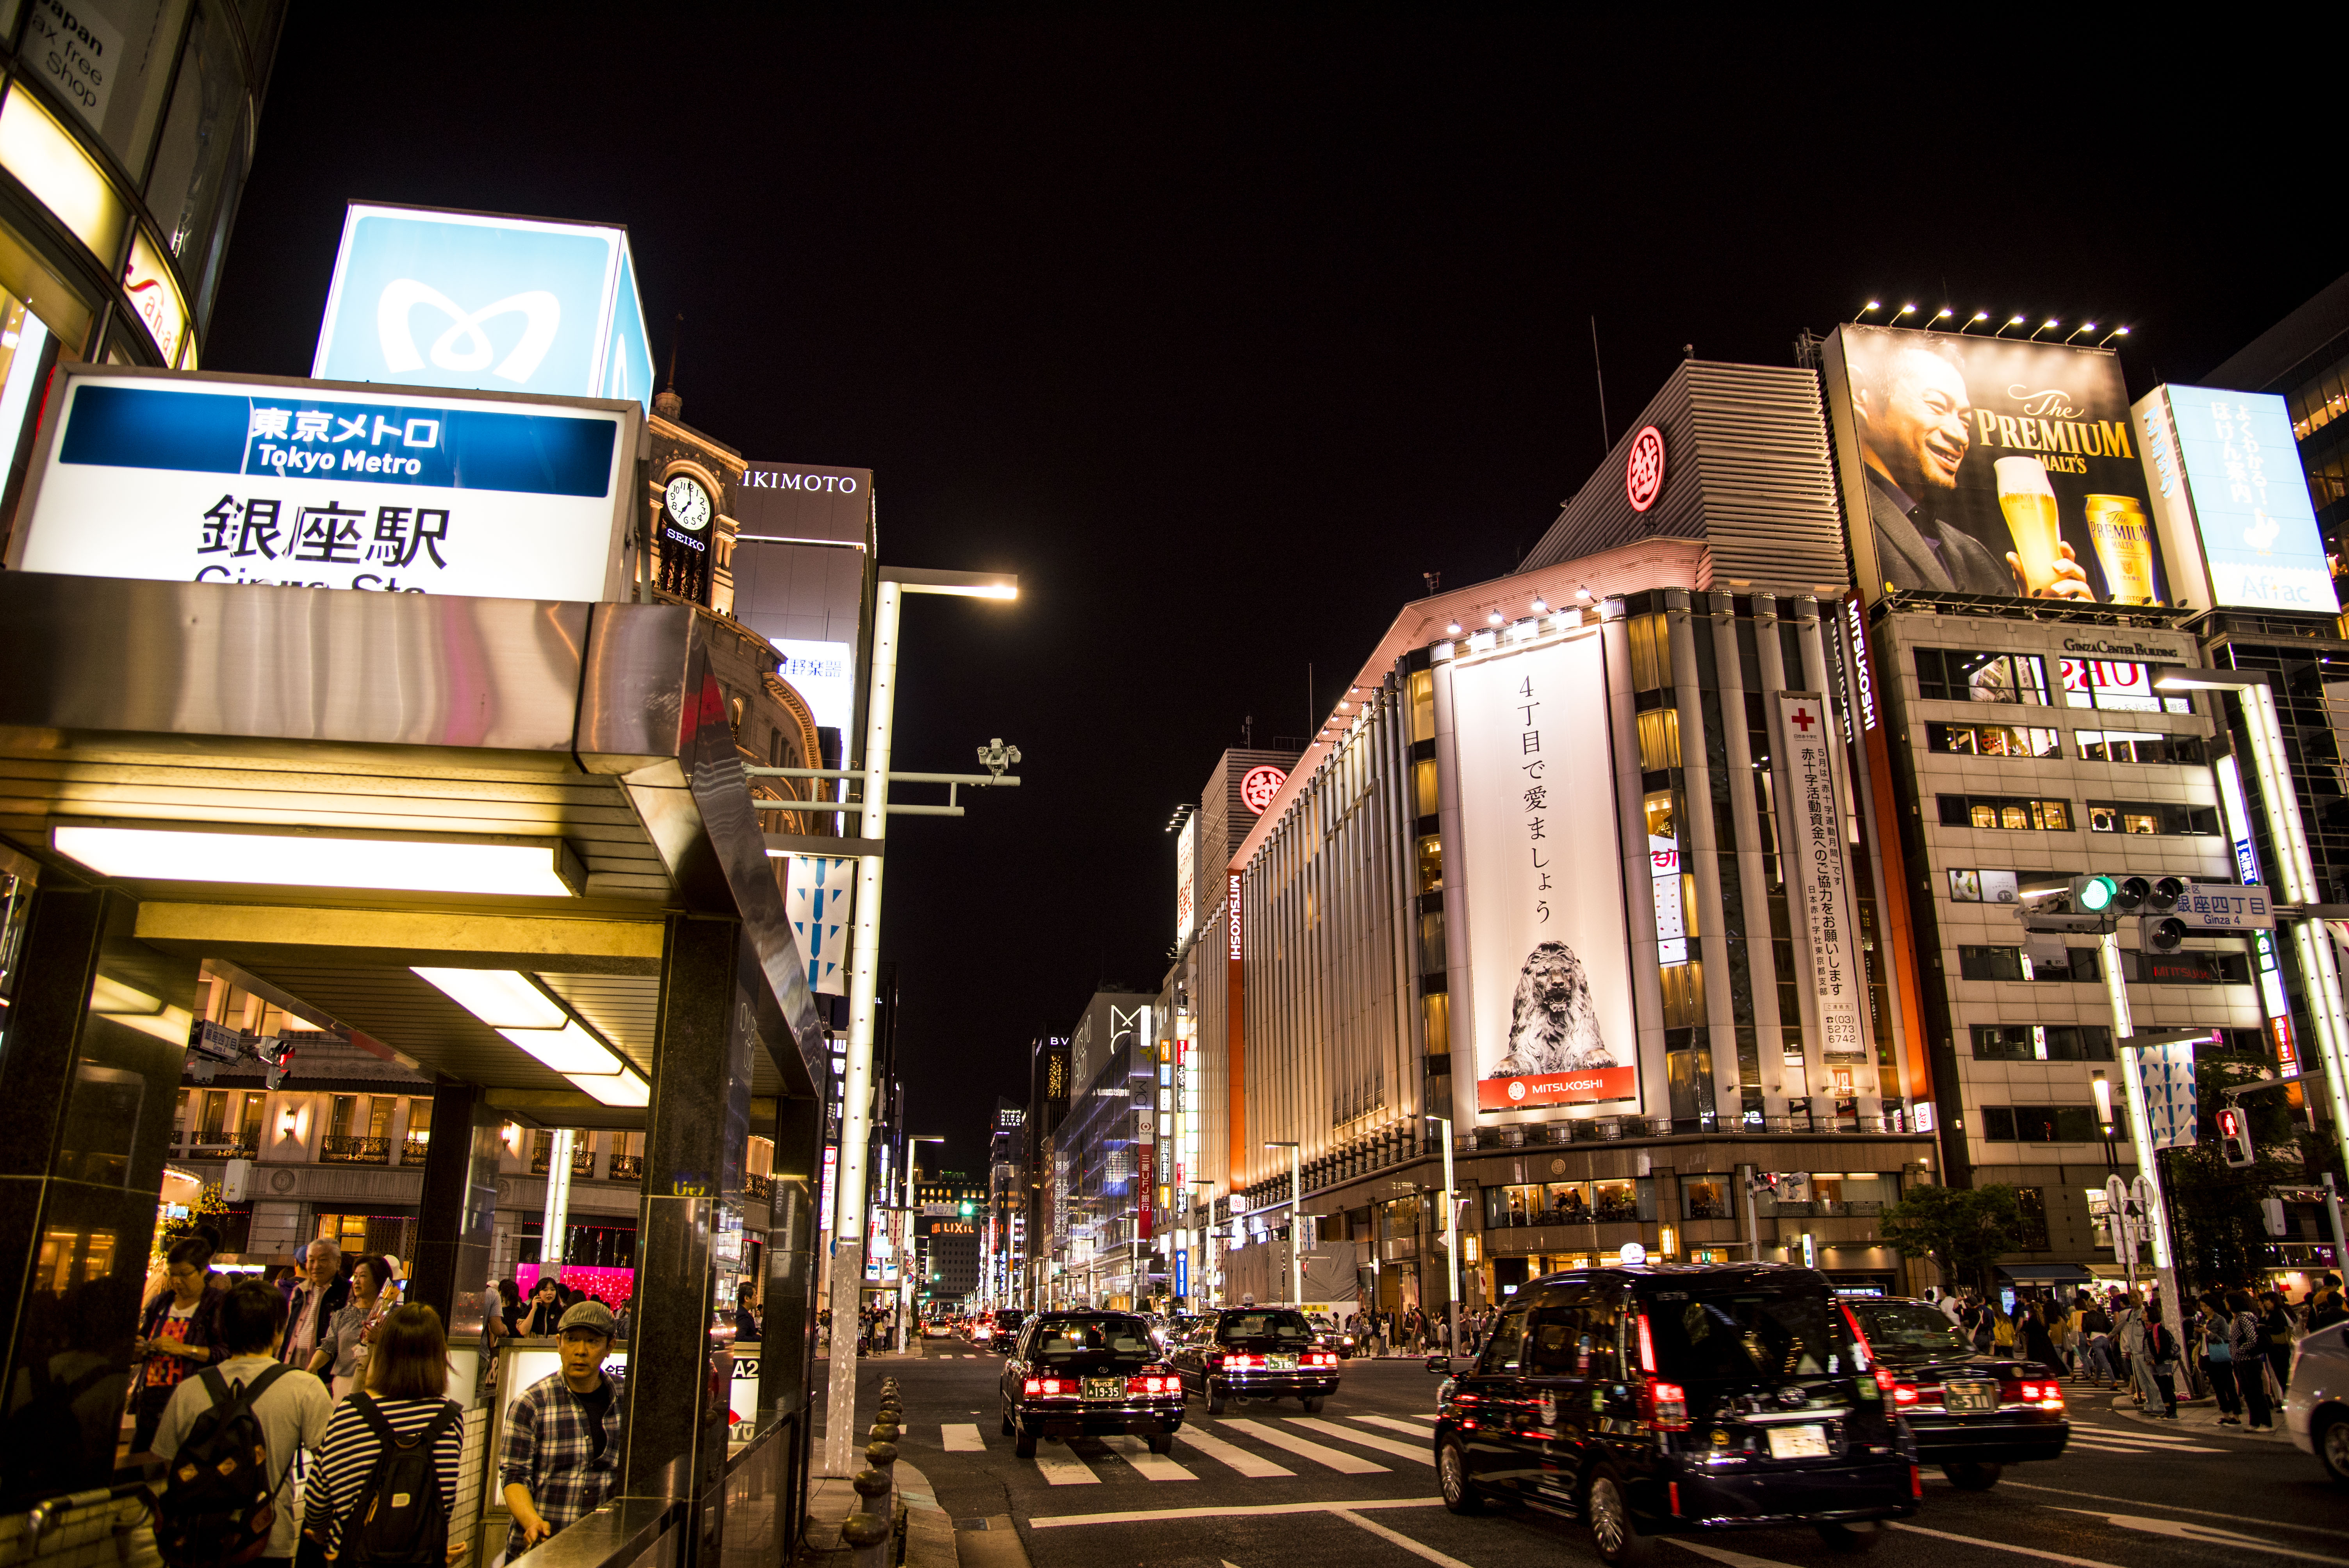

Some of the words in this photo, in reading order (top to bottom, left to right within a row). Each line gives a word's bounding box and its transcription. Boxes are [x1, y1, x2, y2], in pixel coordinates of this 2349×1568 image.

[43, 0, 102, 57] apan
[65, 41, 102, 86] free
[46, 52, 97, 107] Shop
[2008, 384, 2085, 419] The
[251, 407, 440, 448] 東京メトロ
[1974, 408, 2135, 459] PREMIUM
[259, 444, 335, 474] Tokyo
[342, 449, 422, 475] Metro
[2143, 405, 2175, 499] アフラック
[2210, 401, 2253, 504] ほけん案内
[2035, 454, 2087, 474] MALT'S
[673, 485, 680, 494] 10
[680, 481, 686, 490] 11
[739, 470, 856, 494] IKIMOTO
[672, 502, 677, 510] 8
[700, 497, 705, 506] 2
[700, 506, 706, 515] 3
[691, 517, 696, 525] 5
[2099, 508, 2133, 524] The
[197, 494, 451, 570] 銀座駅
[667, 528, 705, 551] SEIKO
[2089, 521, 2151, 542] PREMIUM
[2111, 540, 2134, 549] MALT'S
[2064, 639, 2098, 652] GINZA
[2097, 640, 2135, 654] CENTER
[2134, 643, 2178, 657] BUILDING
[1848, 599, 1876, 731] MITSUKOSHI
[1517, 675, 1552, 924] 4丁目で愛ましょう
[2177, 895, 2266, 915] 銀座四丁目
[1230, 875, 1241, 960] MITSUKOSHI
[2204, 914, 2231, 925] Ginza
[2234, 916, 2241, 925] 4
[1808, 885, 1828, 996] 日本赤十字社東京都支部
[1827, 1025, 1855, 1034] 5273
[1834, 1015, 1855, 1024] (03)
[213, 1043, 223, 1052] Ginza
[1829, 1035, 1856, 1043] 6742
[1532, 1079, 1603, 1094] MITSUKOSHI
[1141, 1155, 1150, 1212] 三菱UFJ銀行
[731, 1360, 759, 1378] A2
[1095, 1387, 1119, 1397] 19-35
